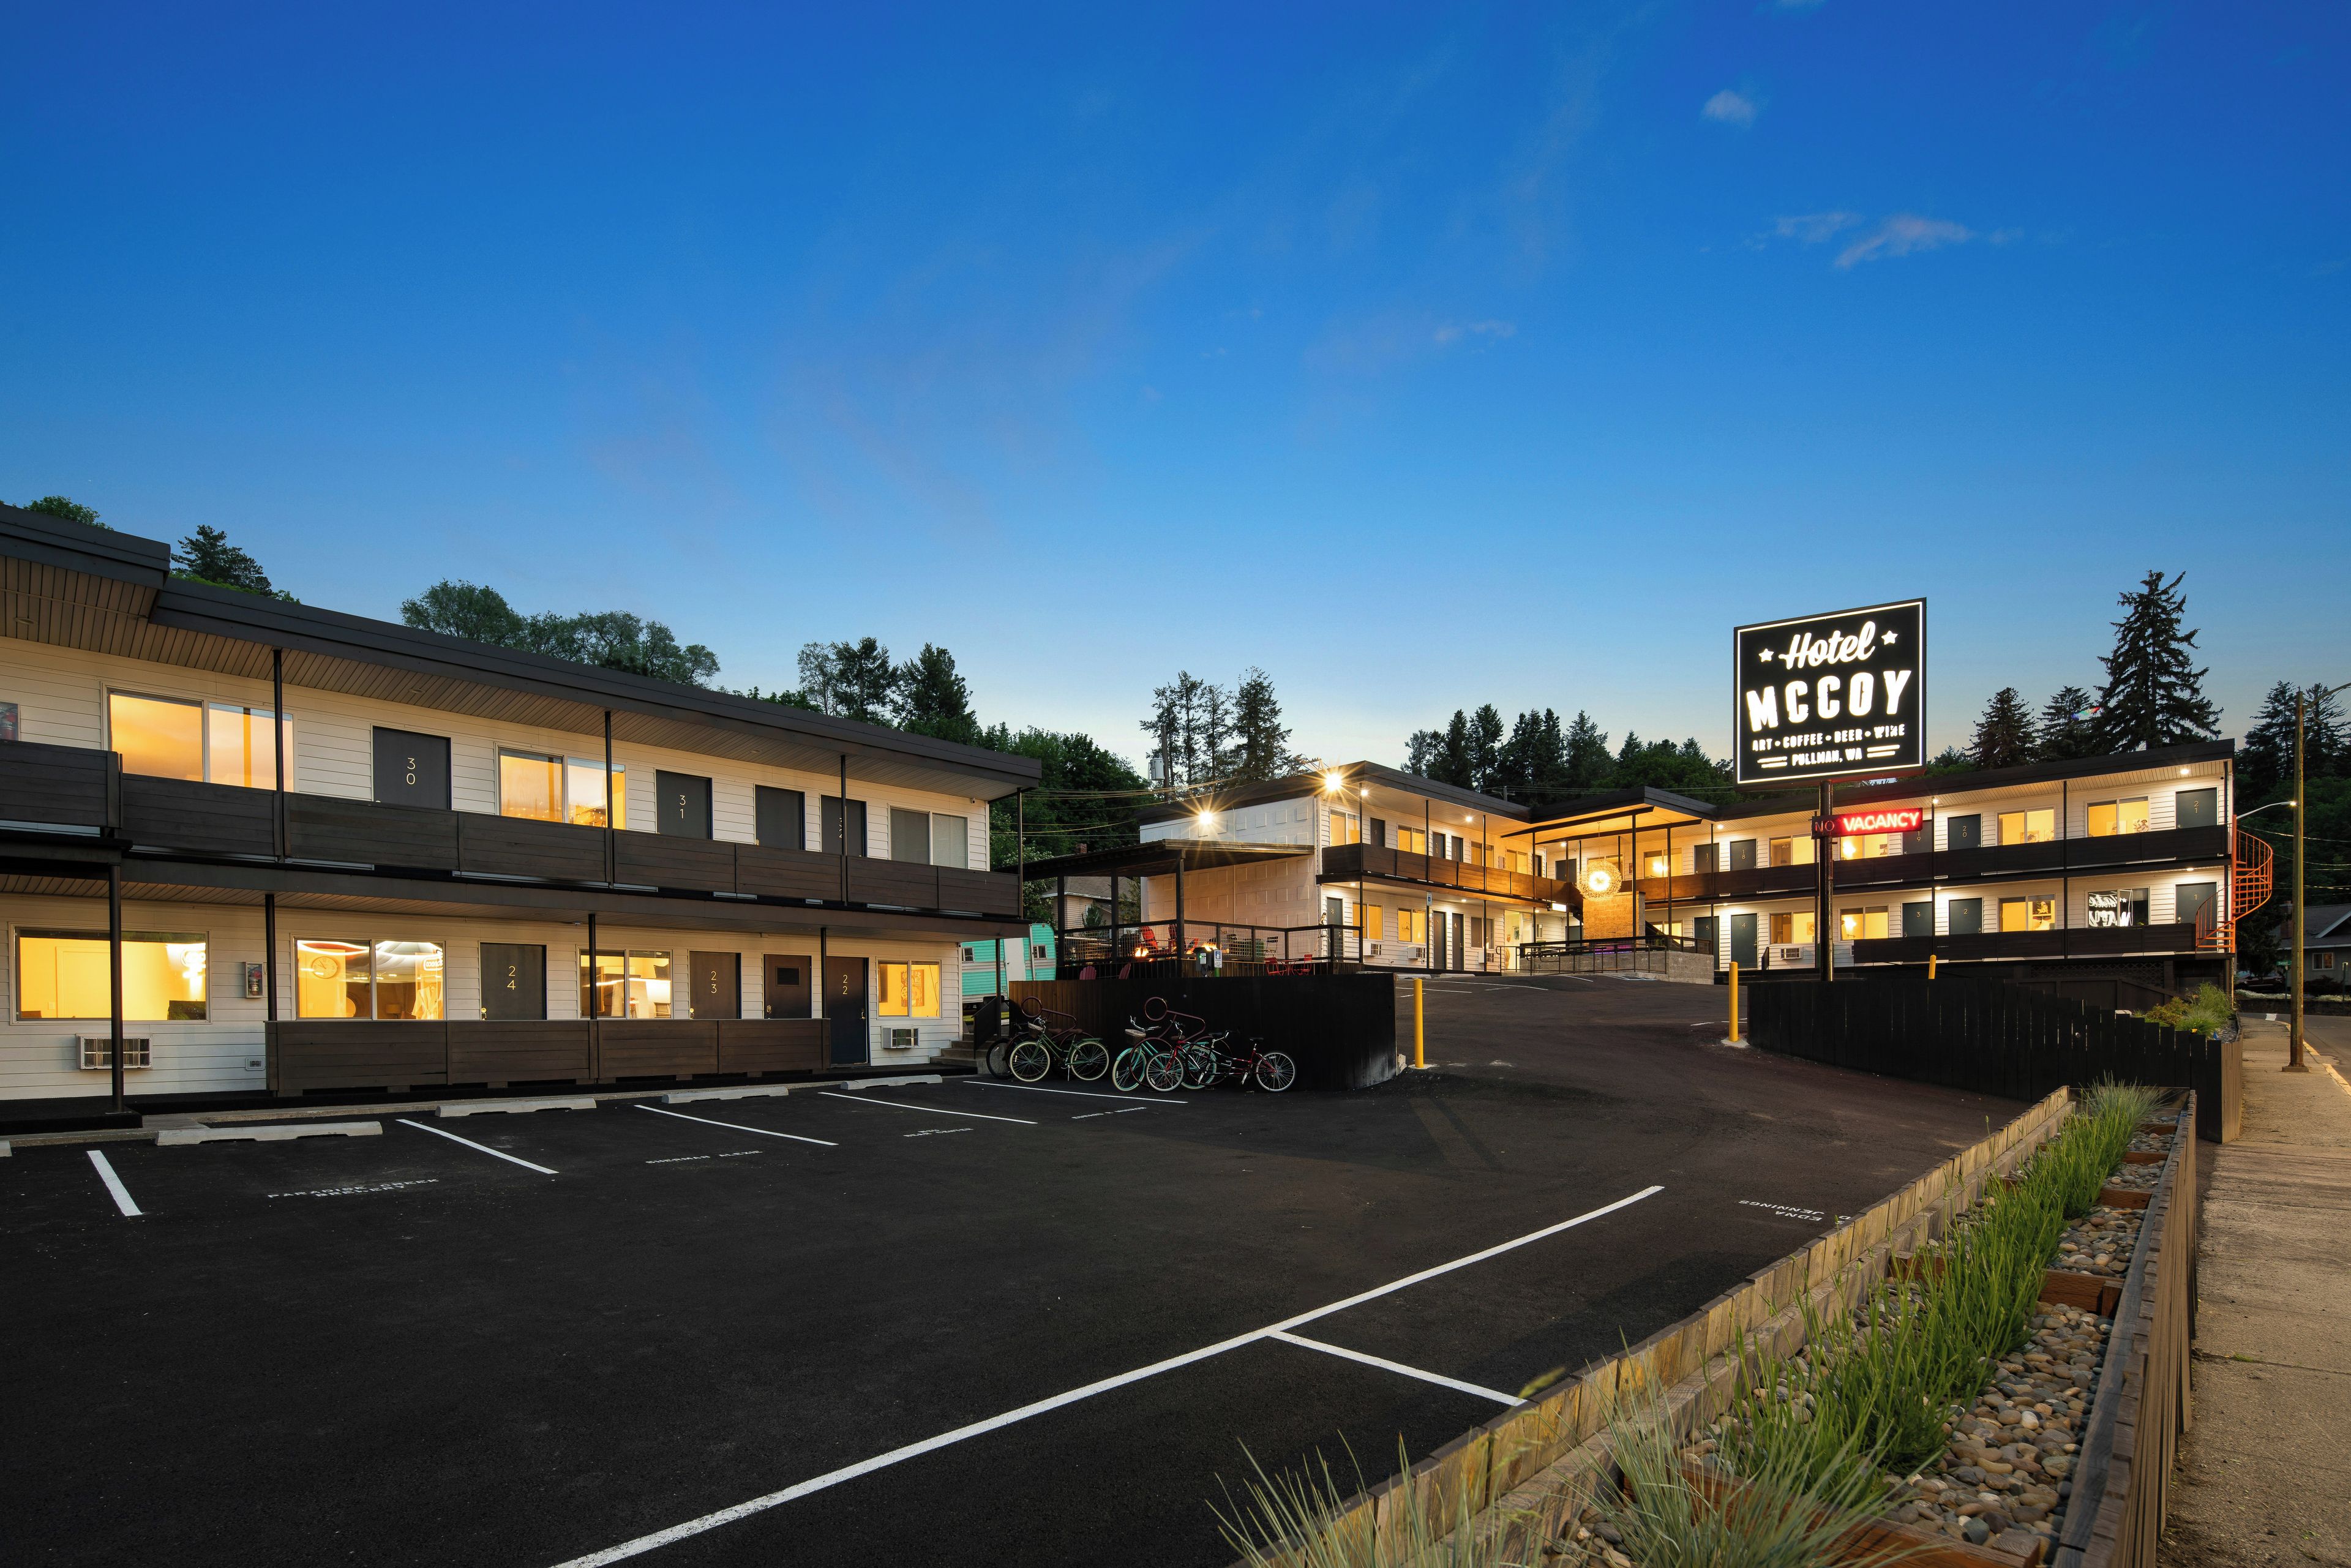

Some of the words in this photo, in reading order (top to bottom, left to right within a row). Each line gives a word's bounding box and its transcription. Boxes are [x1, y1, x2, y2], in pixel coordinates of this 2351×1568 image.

[1778, 621, 1876, 670] Hotel
[1746, 670, 1911, 732] MCCOY
[1752, 738, 1772, 752] ART
[1783, 733, 1823, 748] COFFEE
[1834, 729, 1863, 743] BEER
[1873, 724, 1905, 739] WINE
[1792, 749, 1843, 767] PULLMAN,
[1845, 747, 1862, 762] WA
[1815, 820, 1835, 833] NO
[1843, 812, 1920, 831] VACANCY
[268, 1185, 367, 1198] PARADISE
[380, 1179, 439, 1187] CREEK
[1738, 1200, 1825, 1215] JENNINGS
[1775, 1210, 1823, 1221] EDNA
